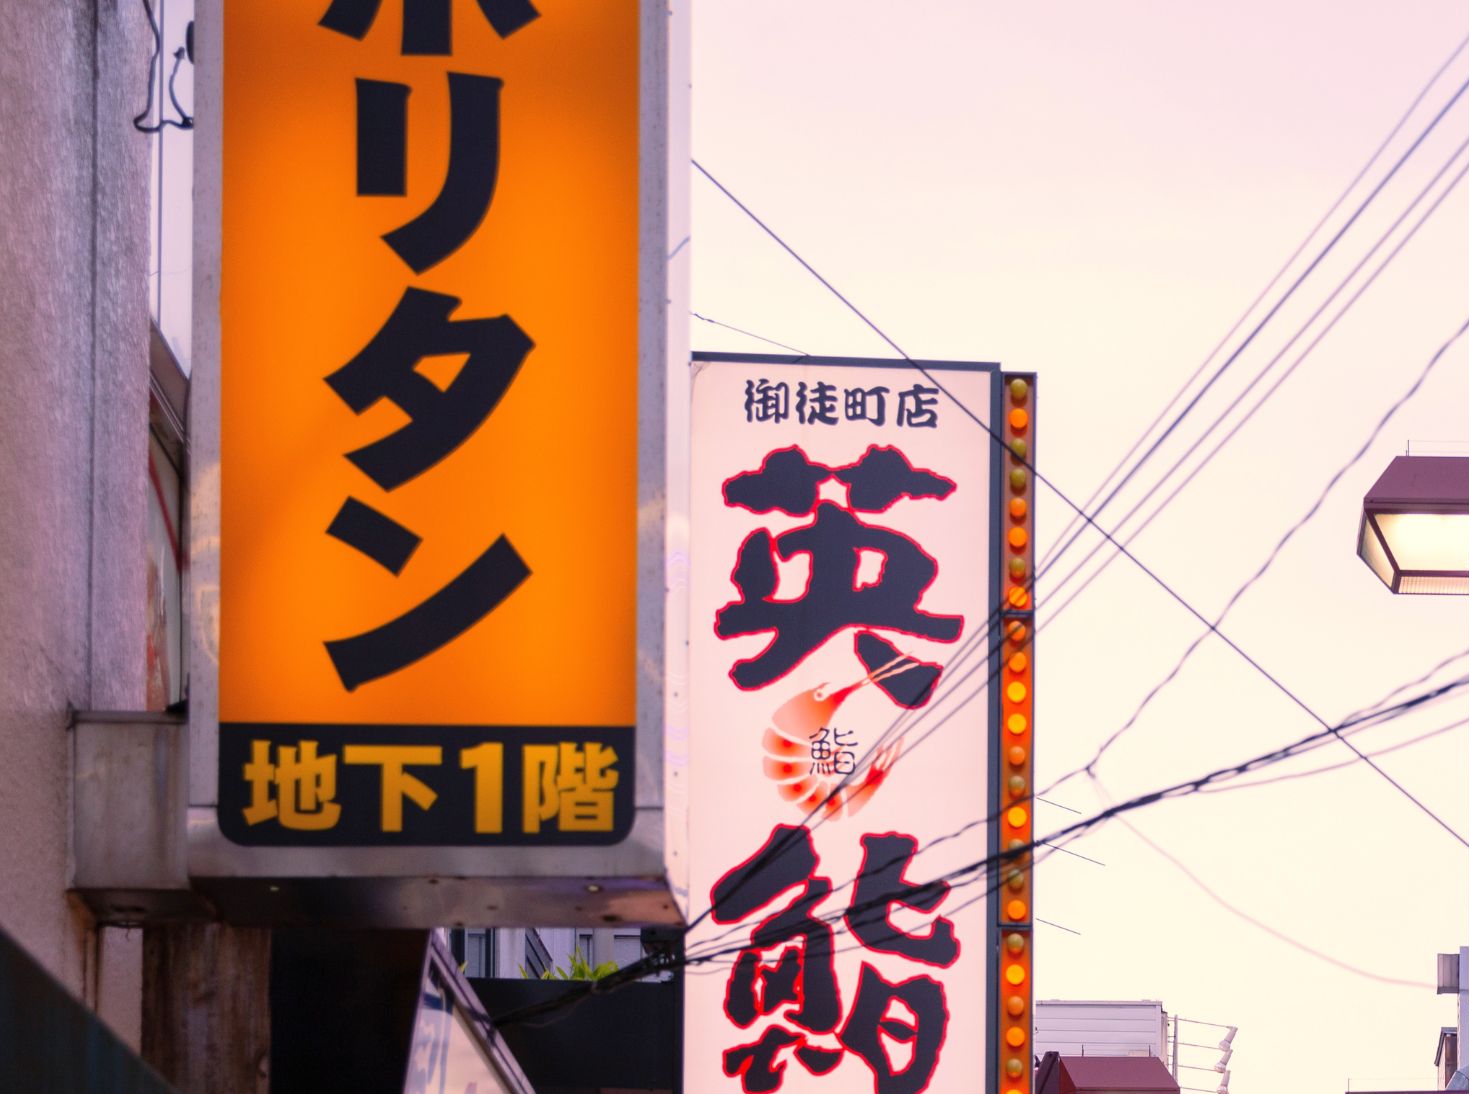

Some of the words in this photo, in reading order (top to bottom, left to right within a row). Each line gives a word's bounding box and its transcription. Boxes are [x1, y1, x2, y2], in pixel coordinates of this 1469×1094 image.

[316, 0, 542, 692] リタン
[743, 378, 940, 428] 御徒町店
[242, 738, 619, 834] 地下1階
